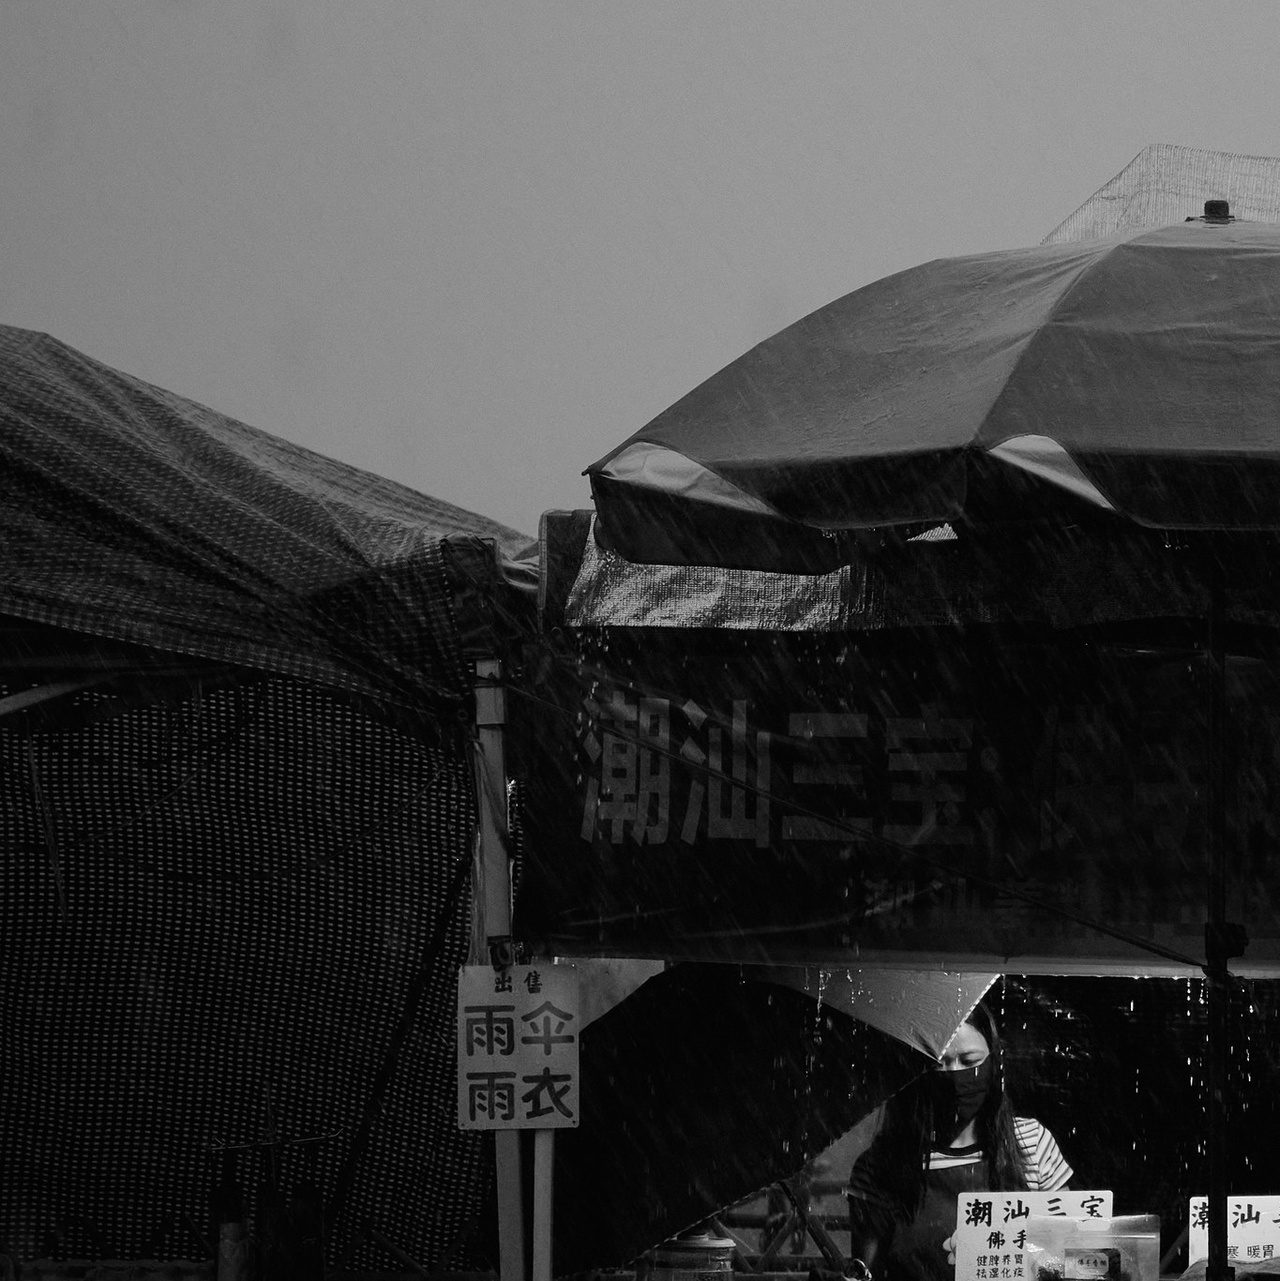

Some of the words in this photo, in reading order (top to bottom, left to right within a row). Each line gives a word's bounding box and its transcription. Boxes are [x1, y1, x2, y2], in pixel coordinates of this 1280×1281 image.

[495, 971, 543, 994] 出售
[464, 1001, 575, 1057] 雨伞
[466, 1067, 574, 1122] 雨衣
[965, 1196, 1105, 1228] 潮汕三宝
[986, 1229, 1027, 1250] 佛手
